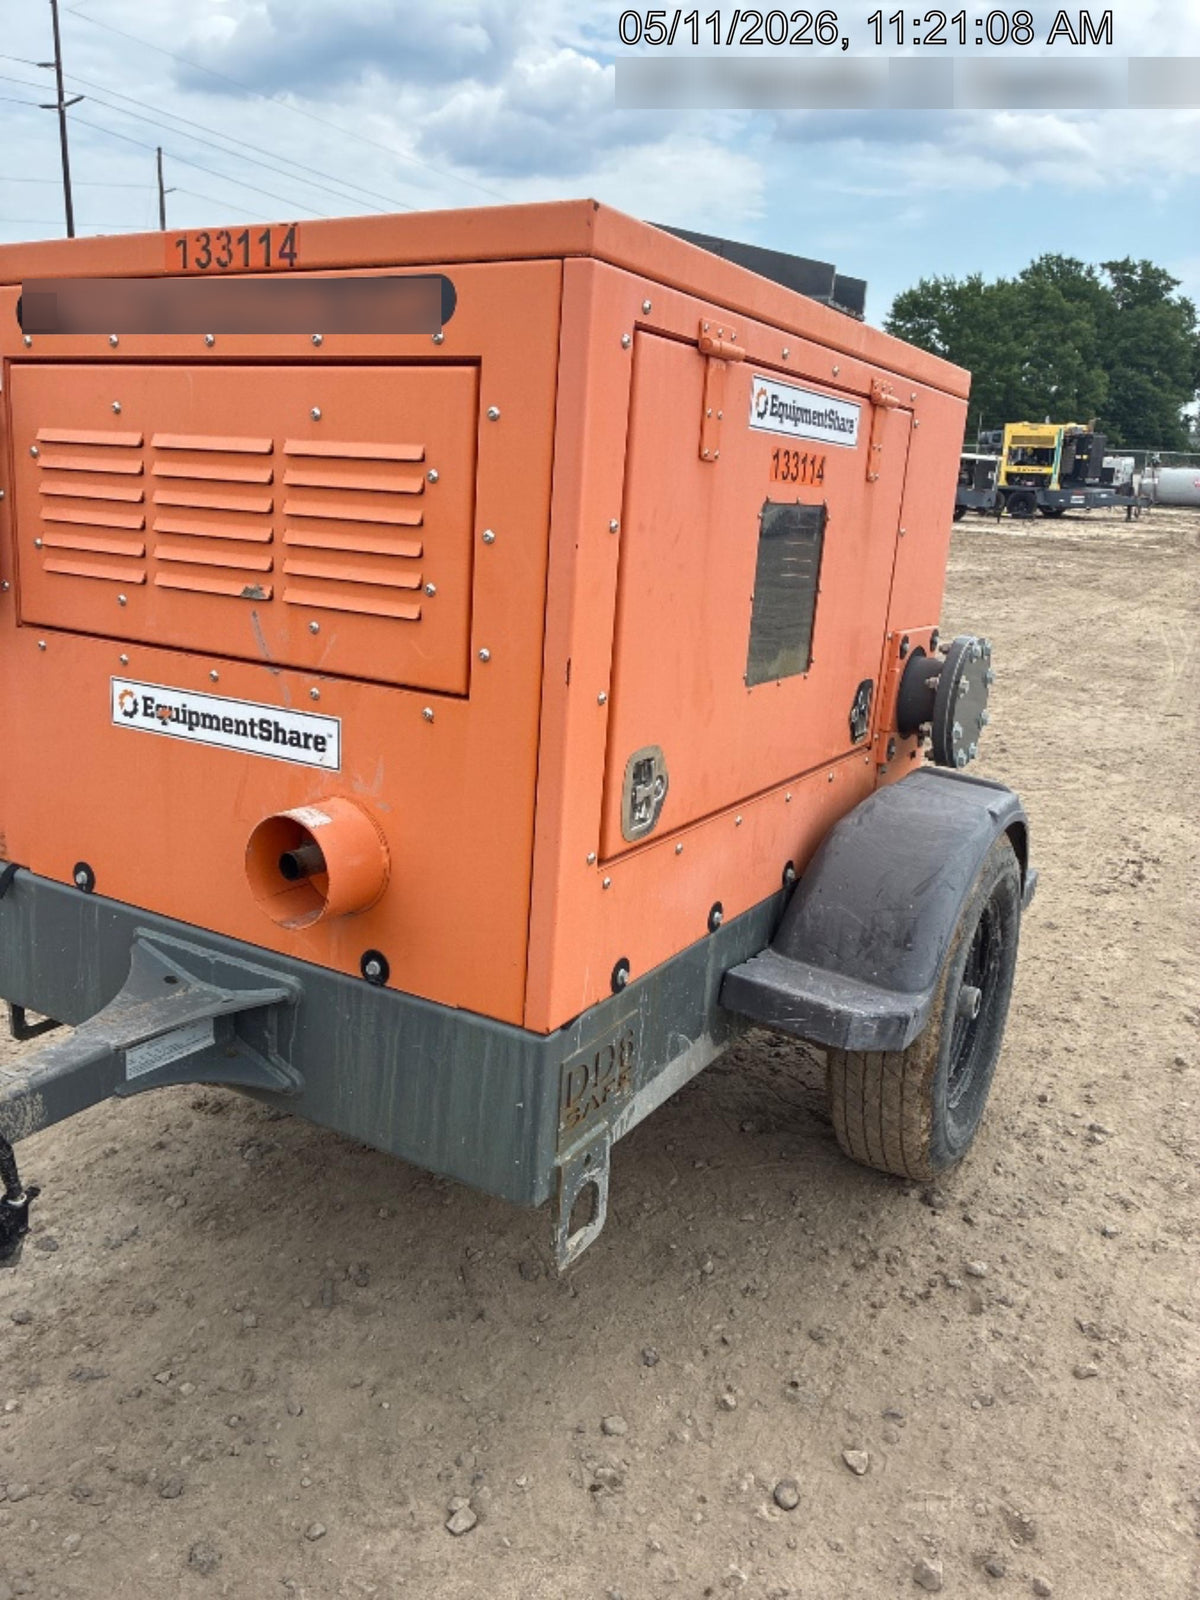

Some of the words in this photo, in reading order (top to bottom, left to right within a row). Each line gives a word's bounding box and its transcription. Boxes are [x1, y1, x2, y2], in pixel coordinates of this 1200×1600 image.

[175, 223, 299, 269] 133114
[769, 394, 855, 434] EquipmentShare
[773, 449, 826, 484] 133114
